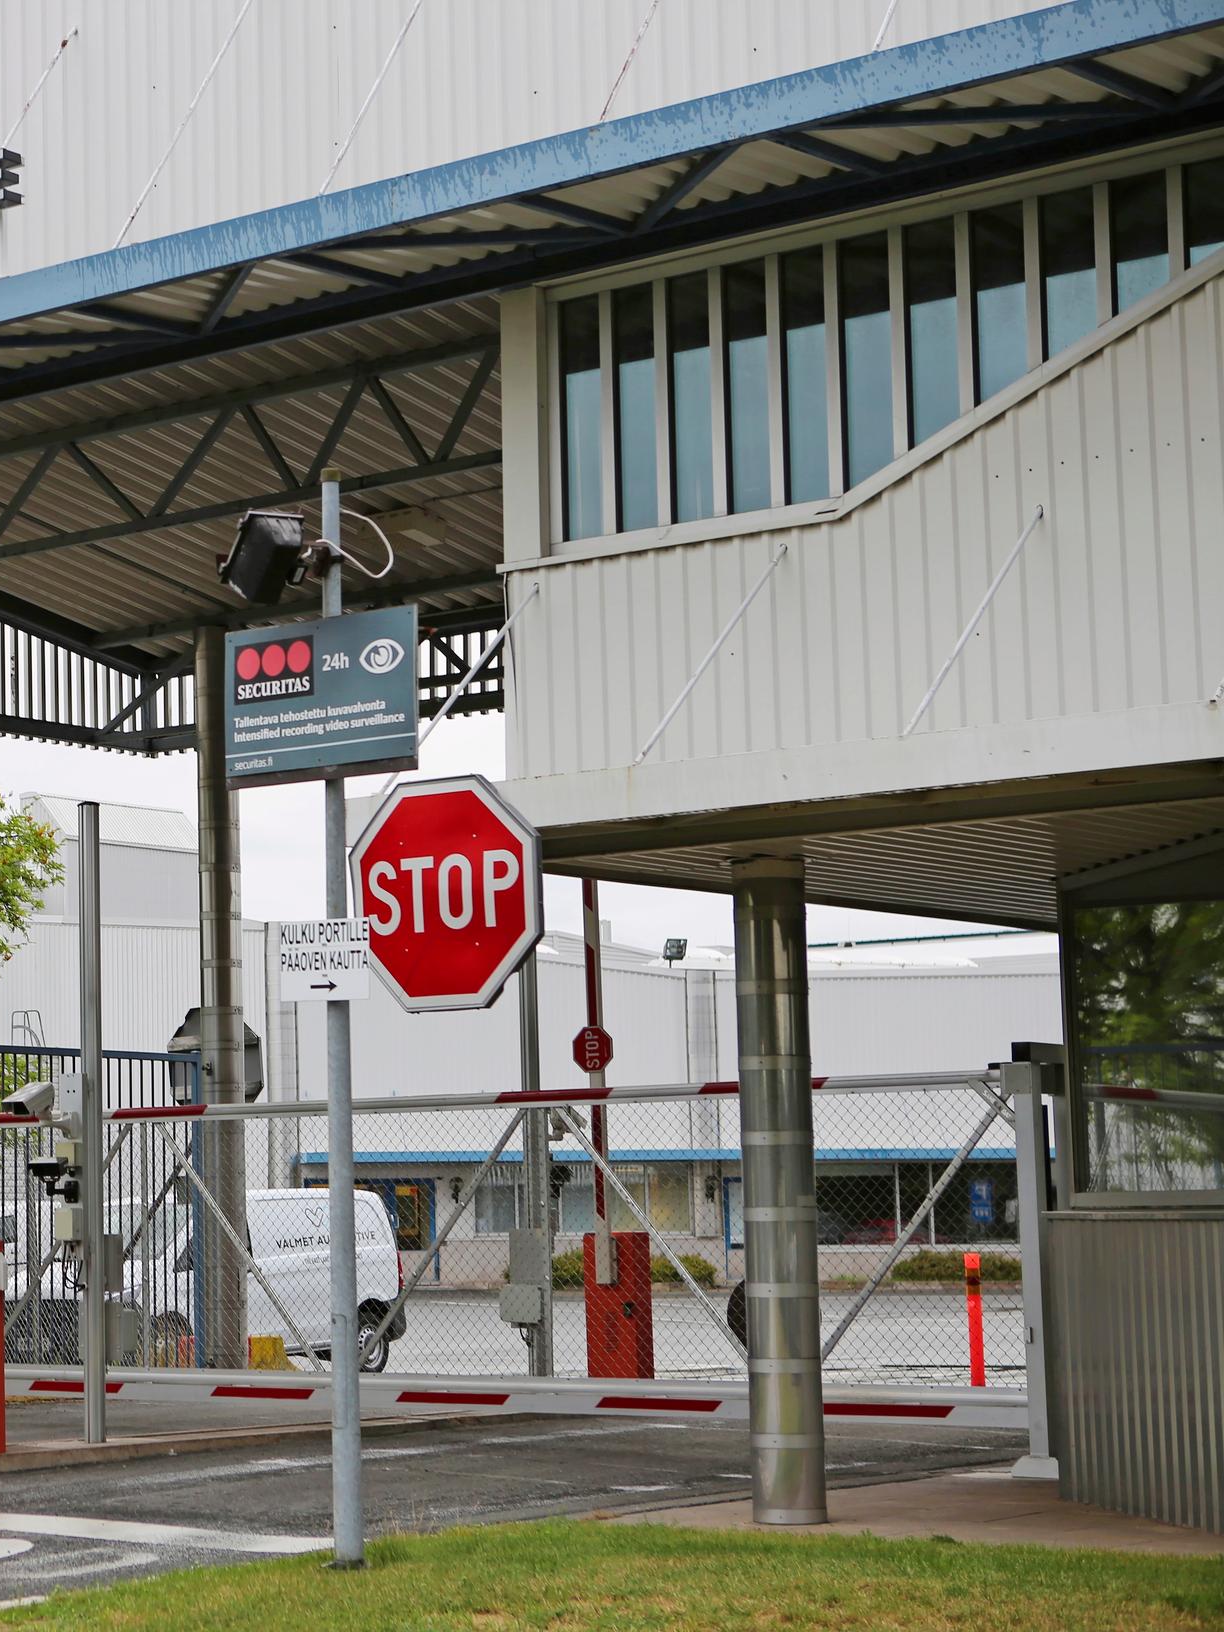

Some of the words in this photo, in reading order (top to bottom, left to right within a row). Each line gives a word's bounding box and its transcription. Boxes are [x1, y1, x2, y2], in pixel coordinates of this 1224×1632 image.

[322, 652, 350, 671] 24h
[237, 676, 311, 700] SECURITAS
[234, 716, 279, 728] Tallentava
[279, 707, 327, 723] tehostettu
[327, 700, 386, 716] kuvavalvonta
[234, 728, 280, 743] Intensified
[282, 722, 324, 736] recording
[325, 719, 350, 732] video
[350, 712, 405, 729] surveillance
[234, 757, 274, 771] securitas.fi
[368, 849, 520, 936] STOP
[281, 923, 316, 945] KULKU
[318, 921, 368, 943] PORTILLE
[281, 948, 327, 972] PÄÄOVEN
[330, 950, 369, 970] KAUTTA
[585, 1031, 600, 1068] STOP
[275, 1236, 314, 1248] VALMET
[317, 1231, 376, 1245] AUTIVE
